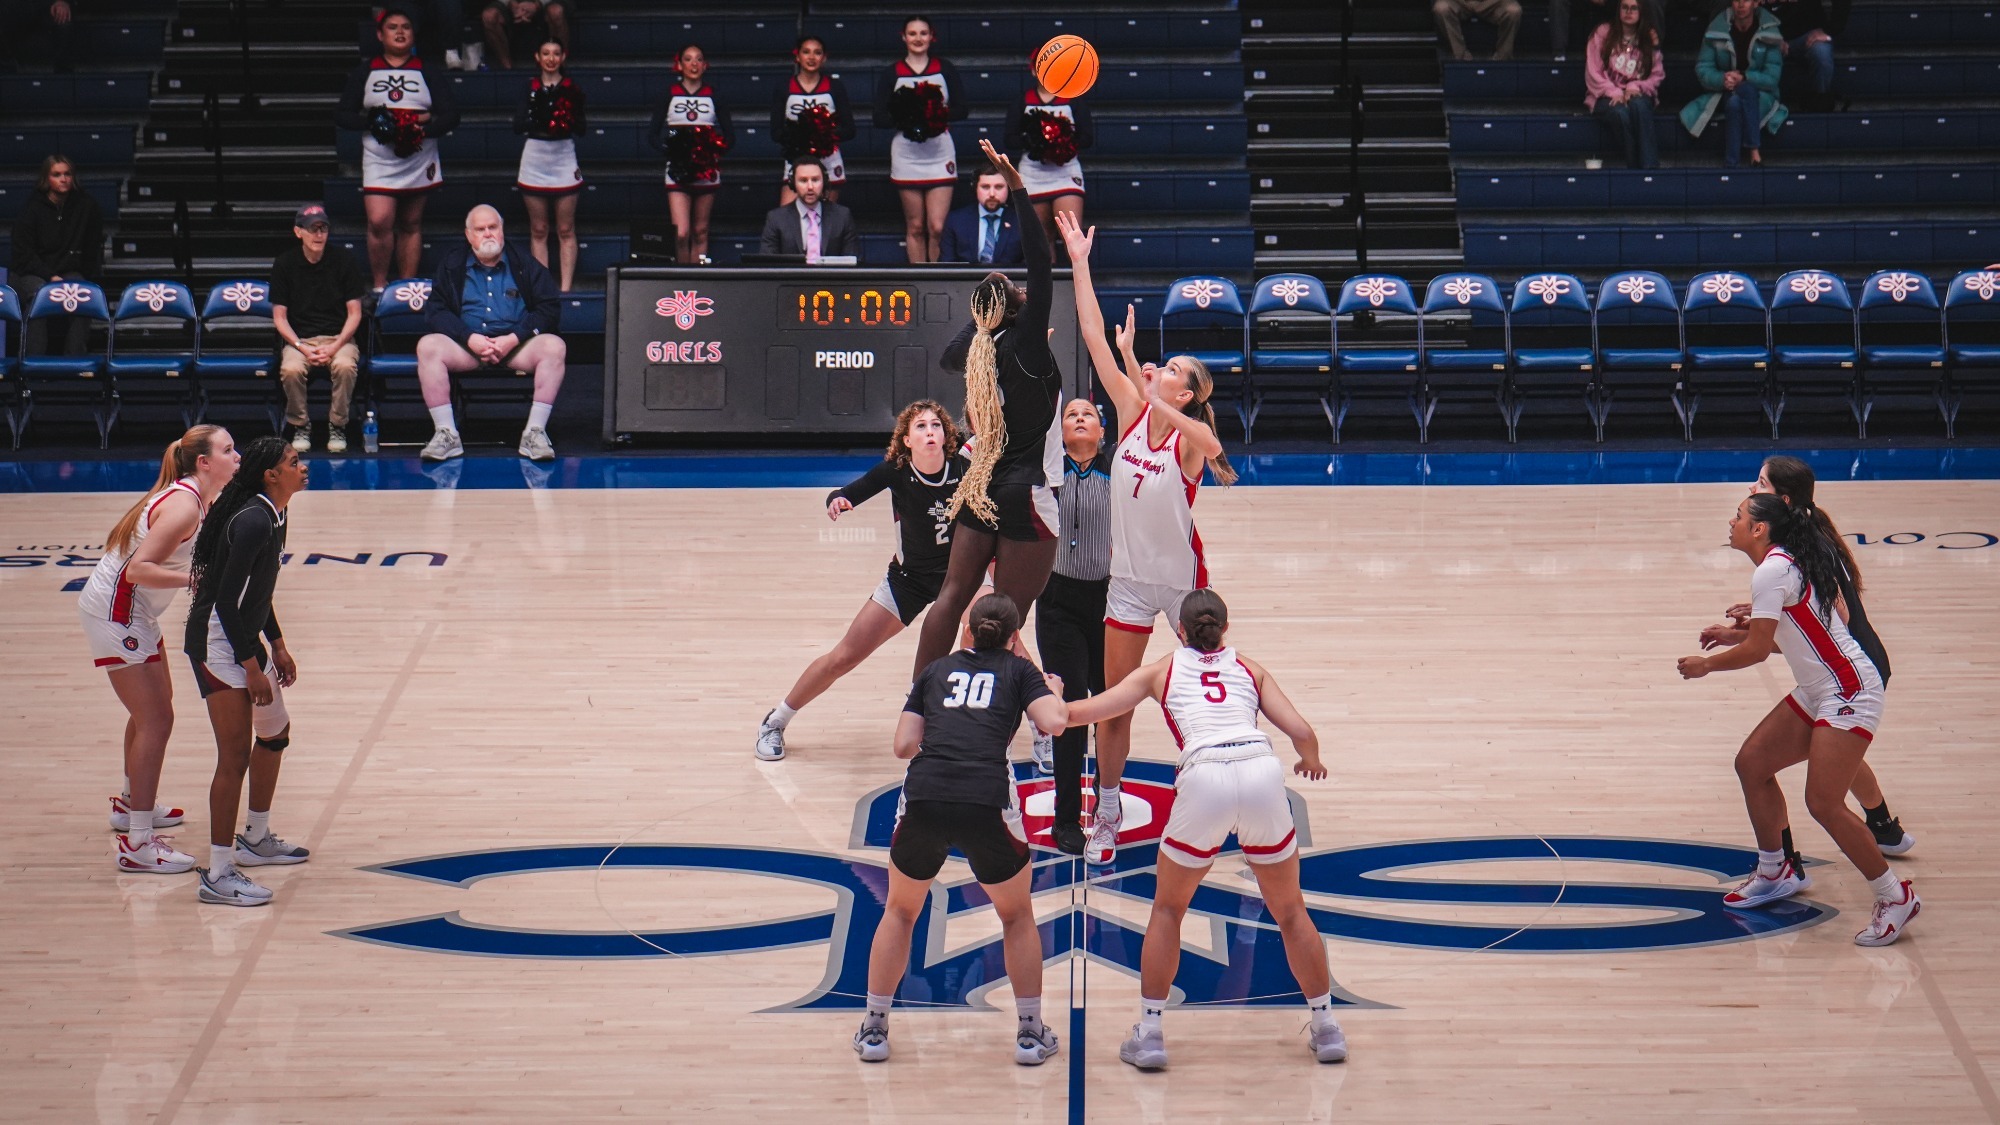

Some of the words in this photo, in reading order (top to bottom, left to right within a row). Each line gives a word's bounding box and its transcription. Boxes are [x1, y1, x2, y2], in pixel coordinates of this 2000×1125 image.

[372, 75, 420, 93] SMC
[674, 100, 710, 114] SMC
[50, 282, 92, 302] SMC
[135, 282, 178, 302] SMC
[222, 282, 265, 301] SMC
[1182, 279, 1224, 298] SMC
[1271, 279, 1310, 297] SMC
[1355, 277, 1397, 296] SMC
[1444, 277, 1482, 295] SMC
[1528, 275, 1570, 295] SMC
[1617, 276, 1656, 294] SMC
[1702, 273, 1745, 293] SMC
[1790, 273, 1832, 292] SMC
[1878, 272, 1920, 292] SMC
[655, 290, 715, 316] SMC
[799, 290, 911, 326] 10:00
[646, 341, 723, 363] GAELS
[815, 351, 875, 369] PERIOD
[1121, 449, 1142, 467] Saint
[1142, 459, 1165, 476] Mary's
[1132, 473, 1145, 499] 7
[934, 523, 950, 545] 2
[16, 544, 105, 552] nion
[943, 671, 995, 708] 30
[1200, 671, 1227, 704] 5
